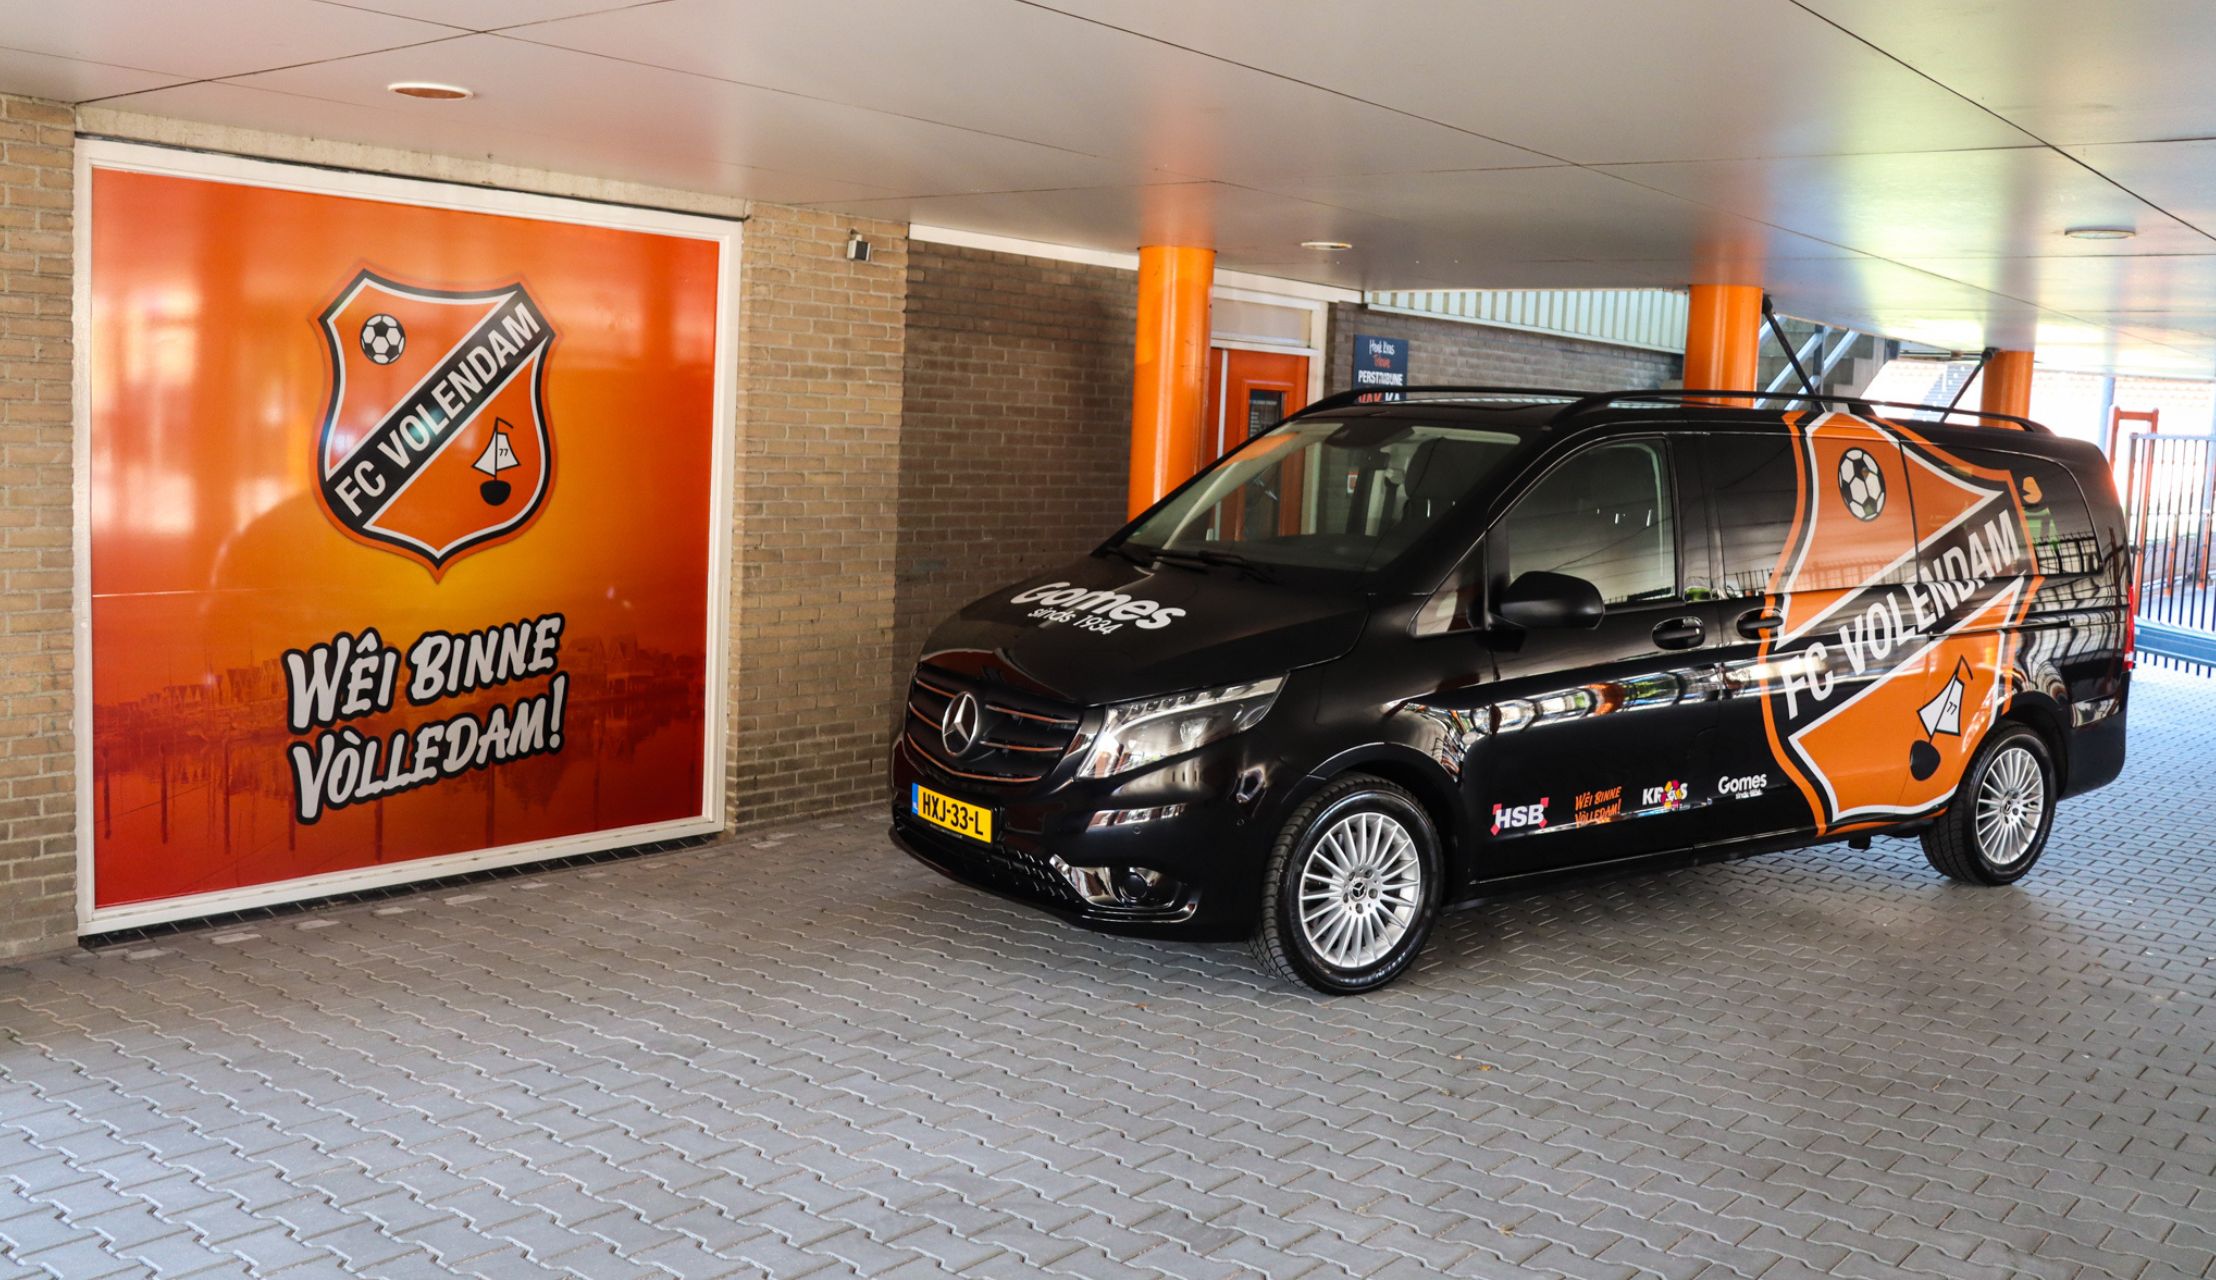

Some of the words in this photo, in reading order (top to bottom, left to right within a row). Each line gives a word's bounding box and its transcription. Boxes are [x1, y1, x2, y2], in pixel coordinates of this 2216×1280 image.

[1358, 370, 1404, 387] PERSTRIBUNE
[334, 460, 387, 517] FC
[377, 302, 541, 469] VOLENDAM
[498, 448, 509, 457] 77
[1010, 581, 1187, 630] Gomes
[1027, 607, 1076, 624] sinds
[1073, 614, 1124, 635] 1934
[1779, 641, 1835, 720] FC
[1838, 509, 2021, 676] VOLENDAM
[410, 616, 562, 700] BINNE
[1946, 701, 1958, 716] 77
[292, 675, 566, 819] VÒLLEDAM!
[1717, 773, 1768, 795] Gomes
[922, 791, 984, 836] HXJ-33-L
[1495, 804, 1545, 829] HSB
